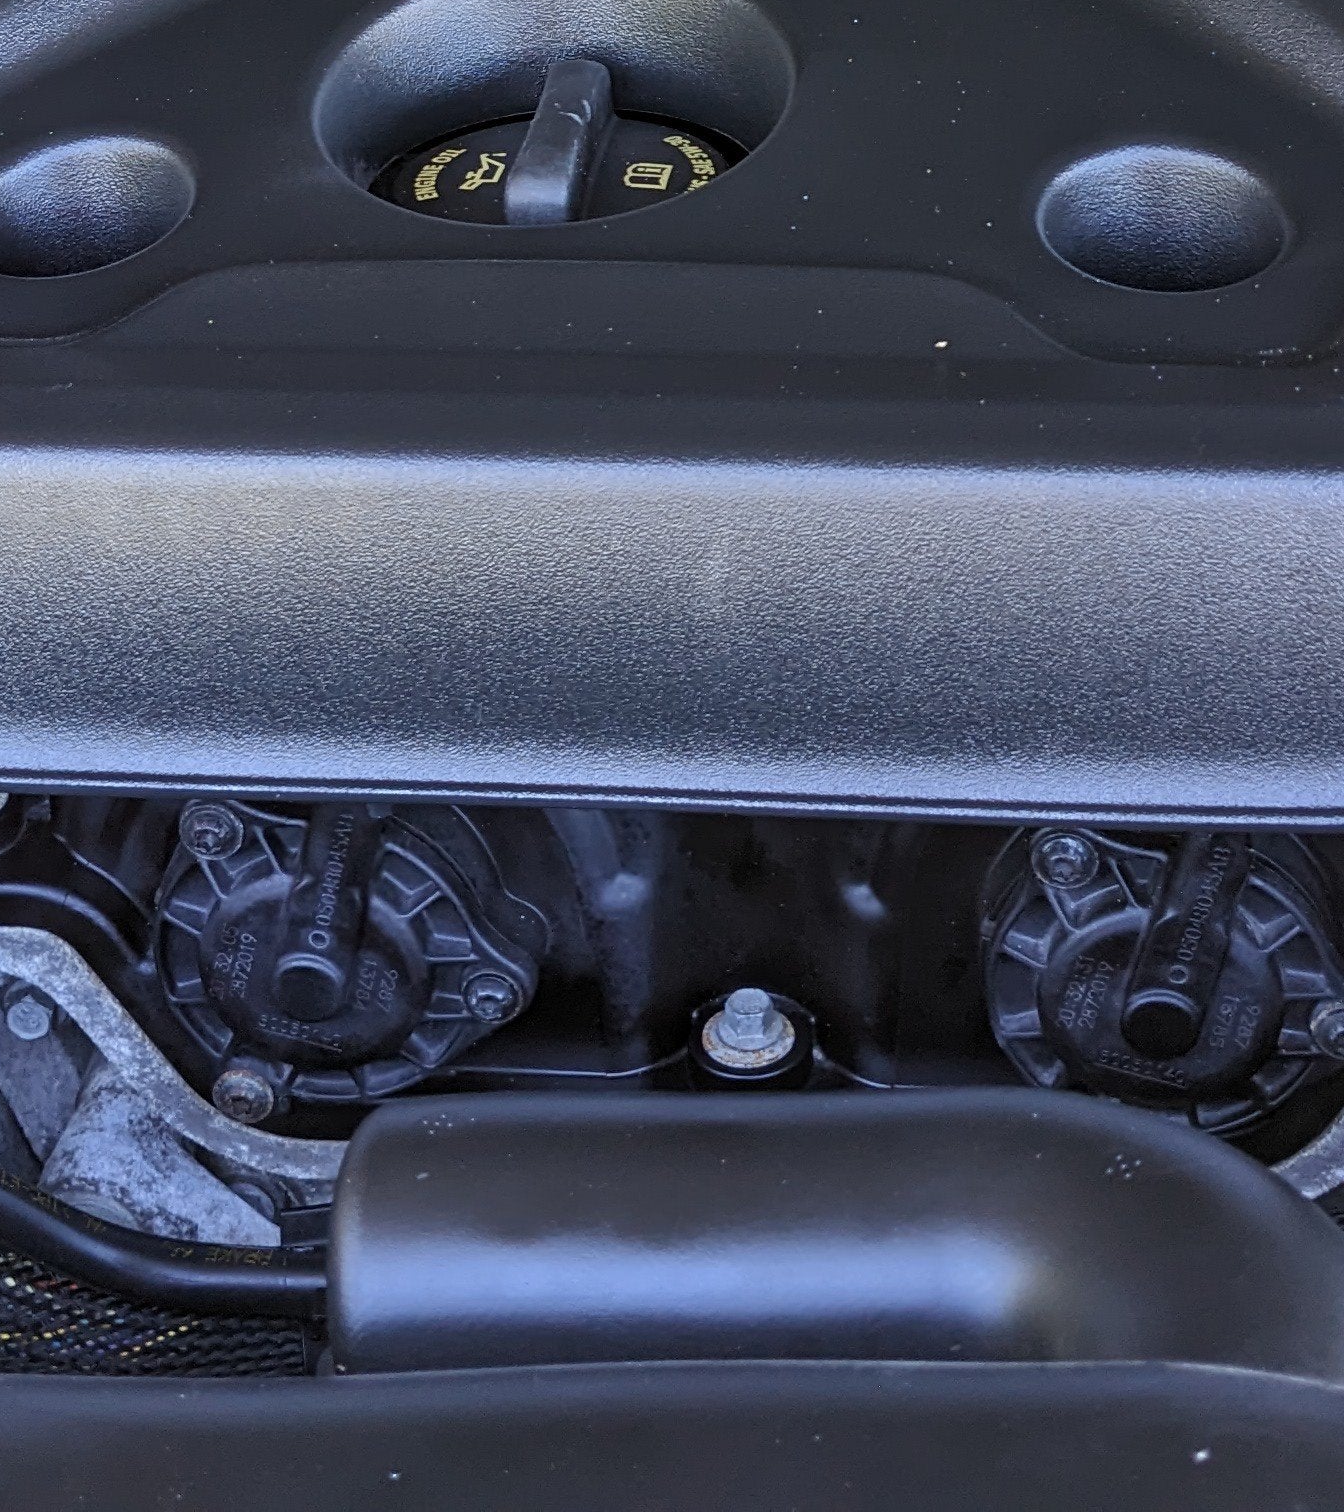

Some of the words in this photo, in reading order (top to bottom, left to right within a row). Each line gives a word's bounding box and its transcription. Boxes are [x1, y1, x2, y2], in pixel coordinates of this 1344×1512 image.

[413, 164, 448, 201] ENGINE
[431, 148, 467, 164] OIL
[690, 159, 716, 175] SAE
